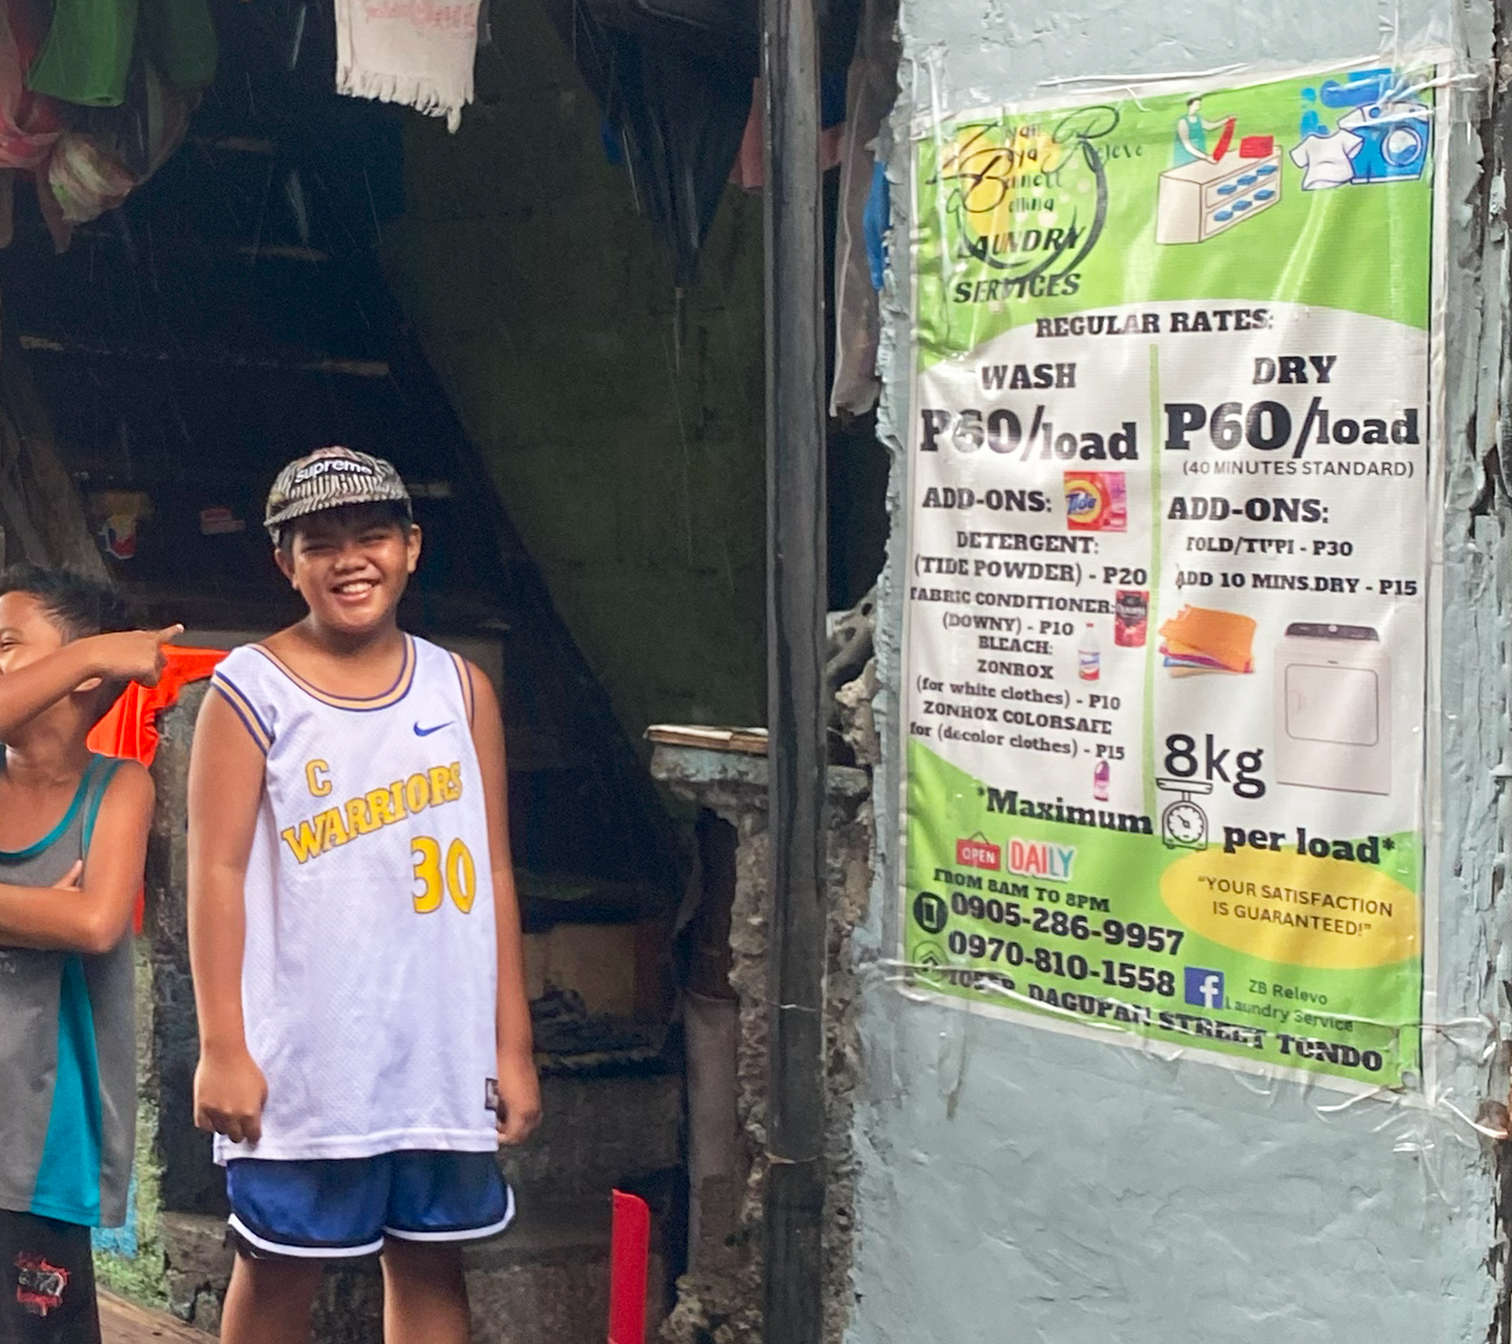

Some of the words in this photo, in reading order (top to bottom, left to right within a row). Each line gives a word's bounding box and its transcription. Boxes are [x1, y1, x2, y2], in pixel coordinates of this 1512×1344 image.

[957, 226, 1086, 259] LAUNDRY
[953, 273, 1081, 304] SERVICES
[1035, 313, 1161, 338] REGULAR
[1170, 308, 1274, 334] RATES:
[981, 362, 1077, 390] WASH
[1252, 355, 1338, 385] DRY
[1164, 396, 1420, 459] P60/load
[294, 459, 373, 484] supreme
[1183, 460, 1210, 477] (40
[1214, 460, 1297, 476] MINUTES
[1302, 460, 1415, 478] STANDARD)
[922, 486, 1052, 513] ADD-ONS:
[1168, 497, 1329, 524] ADD-ONS:
[956, 531, 1100, 555] DETERGENT:
[1312, 540, 1354, 557] P30
[914, 554, 969, 577] (TIDE
[974, 559, 1083, 587] POWDER)
[1102, 566, 1147, 586] P20
[1176, 570, 1213, 587] ADD
[1221, 572, 1246, 588] 10
[1379, 579, 1418, 596] P15
[910, 586, 971, 604] FABRIC
[975, 591, 1115, 615] CONDITIONER:
[942, 611, 1022, 636] (DOWNY)
[1039, 620, 1074, 636] P10
[978, 635, 1054, 655] BLEACH:
[977, 658, 1055, 680] ZONROX
[916, 674, 944, 694] (for
[950, 681, 997, 698] white
[1000, 685, 1071, 709] clothes)
[1089, 693, 1122, 710] P10
[923, 700, 998, 723] ZONROX
[1002, 709, 1113, 735] COLORSAFE
[909, 721, 932, 737] for
[937, 723, 1005, 746] (decolor
[1009, 735, 1079, 758] clothes)
[1095, 743, 1125, 761] P15
[305, 759, 333, 797] C
[1164, 733, 1266, 799] 8kg
[280, 761, 463, 864] WARRIORS
[1223, 825, 1286, 854] per
[962, 846, 996, 864] OPEN
[1010, 839, 1076, 879] DAILY
[410, 835, 477, 915] 30
[933, 868, 983, 890] FROM
[987, 878, 1030, 900] 8AM
[1034, 887, 1060, 904] TO
[1065, 893, 1111, 913] 8PM
[1260, 884, 1394, 918] SATISFACTION
[1212, 900, 1230, 916] IS
[950, 892, 1185, 956] 0905-286-9957
[948, 930, 1176, 998] 0970-810-1558
[1248, 978, 1267, 996] ZB
[1272, 983, 1328, 1005] Relevo
[1226, 996, 1289, 1024] Laundry
[1293, 1009, 1354, 1032] Service
